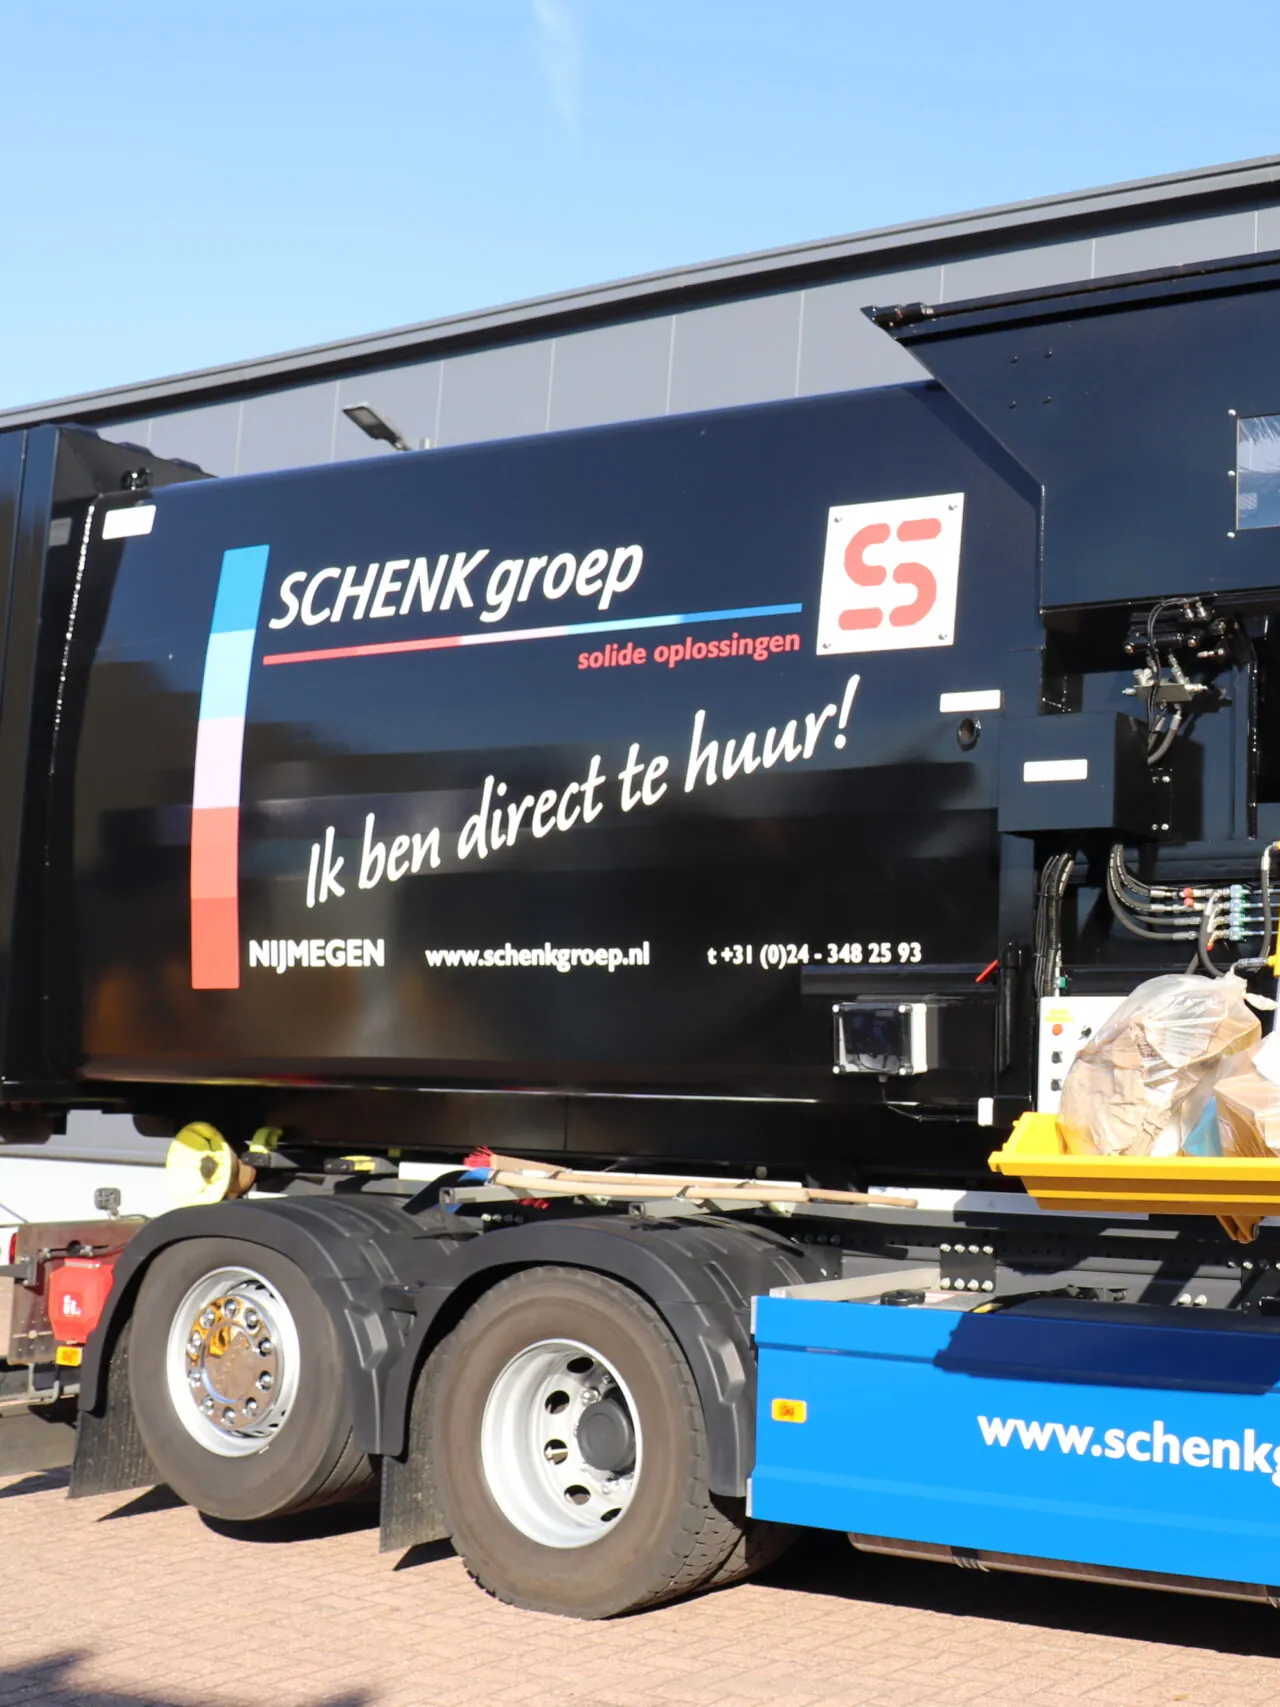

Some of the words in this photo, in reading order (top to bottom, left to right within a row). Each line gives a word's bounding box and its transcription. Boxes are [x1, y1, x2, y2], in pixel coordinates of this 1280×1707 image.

[268, 548, 490, 630] SCHENK
[480, 544, 644, 625] groep
[578, 643, 648, 671] solide
[653, 632, 802, 669] oplossingen
[305, 825, 346, 909] Ik
[357, 812, 442, 890] ben
[456, 754, 607, 861] direct
[617, 742, 670, 813] te
[683, 673, 861, 793] huur!
[248, 937, 386, 975] NIJMEGEN
[424, 938, 651, 974] www.schenkgroep.nl
[720, 944, 753, 965] +31
[759, 943, 810, 970] (0)24
[827, 942, 863, 964] 348
[867, 942, 892, 964] 25
[897, 941, 922, 963] 93
